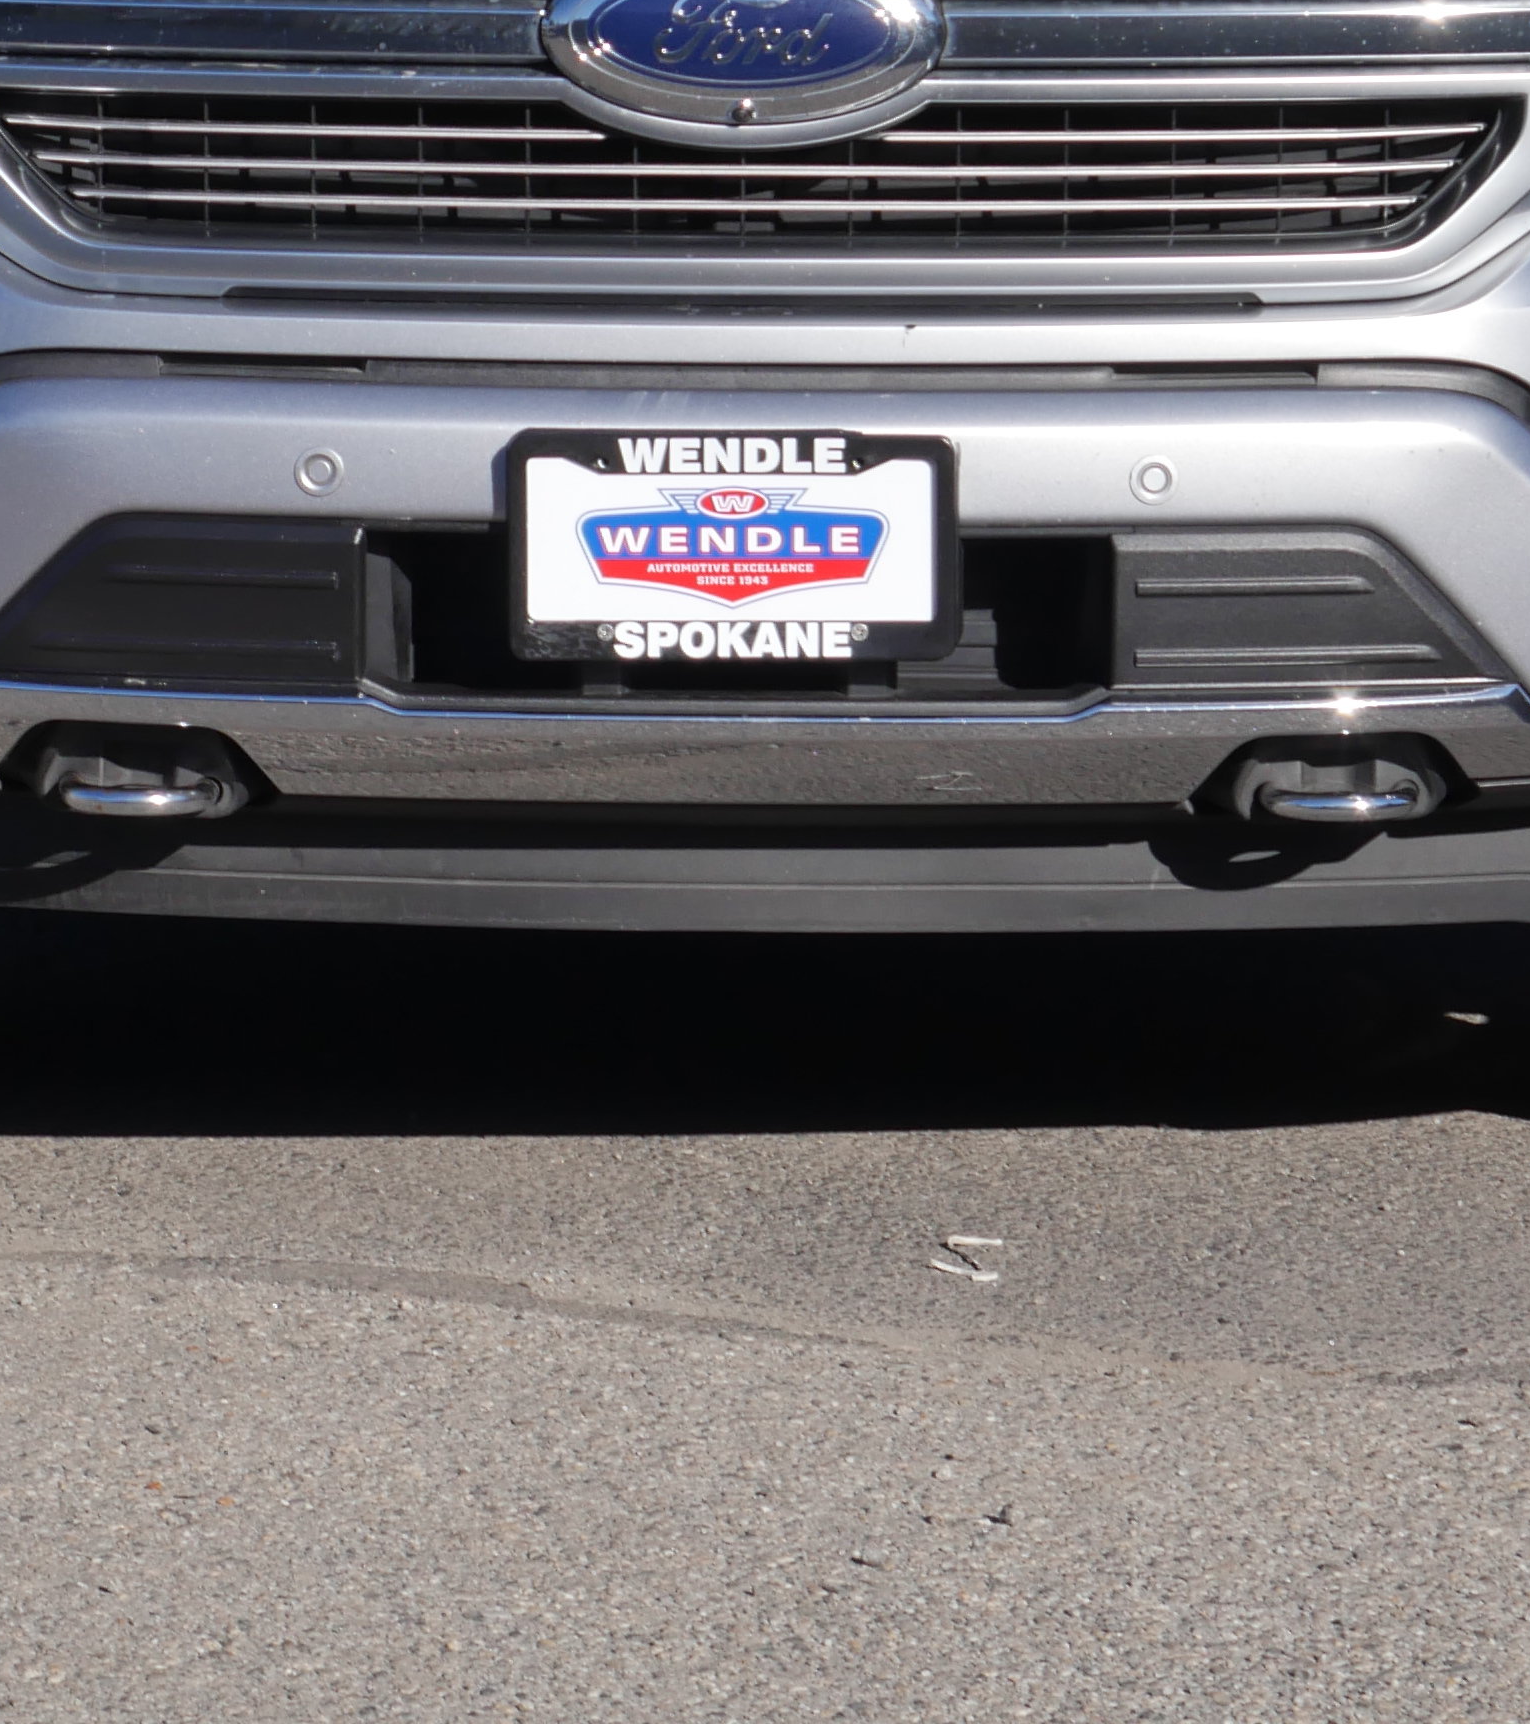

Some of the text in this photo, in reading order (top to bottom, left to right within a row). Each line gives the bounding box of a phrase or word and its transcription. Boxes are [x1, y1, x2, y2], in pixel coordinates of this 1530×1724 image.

[618, 436, 847, 475] WENDLE
[599, 525, 861, 554] WENDLE
[647, 561, 814, 573] AUTOMOTIVE EXCELLENCE
[696, 575, 769, 586] SINCE 1943
[613, 621, 853, 660] SPOKANE
